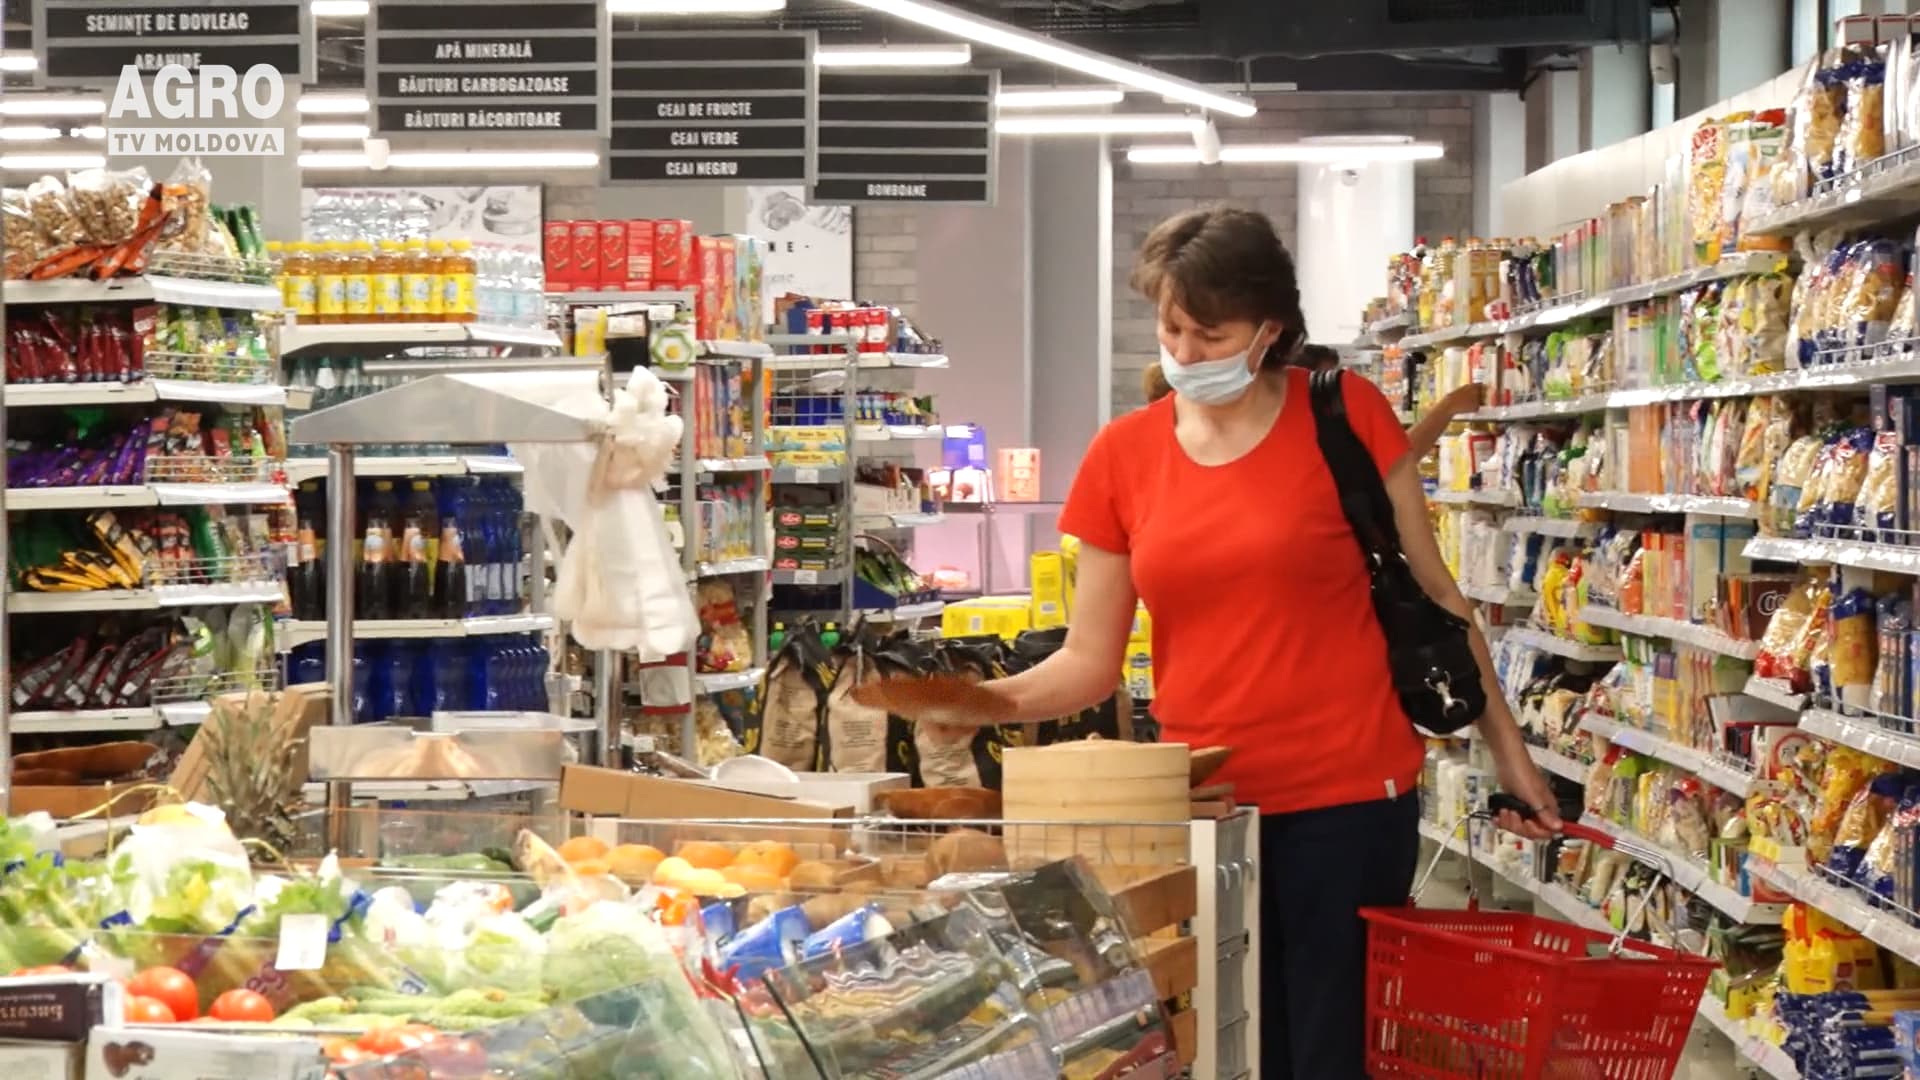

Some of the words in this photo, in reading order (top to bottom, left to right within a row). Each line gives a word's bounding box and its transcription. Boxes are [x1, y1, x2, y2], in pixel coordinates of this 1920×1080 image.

[156, 14, 175, 31] DE
[179, 13, 249, 31] DOVLEAC
[436, 42, 461, 59] APĂ
[466, 41, 532, 58] MINERALĂ
[134, 54, 202, 70] ARAHIDE
[399, 76, 458, 92] BĂUTURI
[461, 77, 569, 93] CARBOGAZOASE
[657, 103, 686, 117] CEAI
[688, 102, 704, 116] DE
[706, 102, 752, 116] FRUCTE
[405, 111, 464, 127] BĂUTURI
[467, 110, 562, 127] RĂCORITOARE
[670, 131, 699, 145] CEAI
[701, 131, 739, 145] VERDE
[665, 161, 694, 176] CEAI
[696, 161, 738, 176] NEGRU
[867, 183, 927, 197] BOMBOANE
